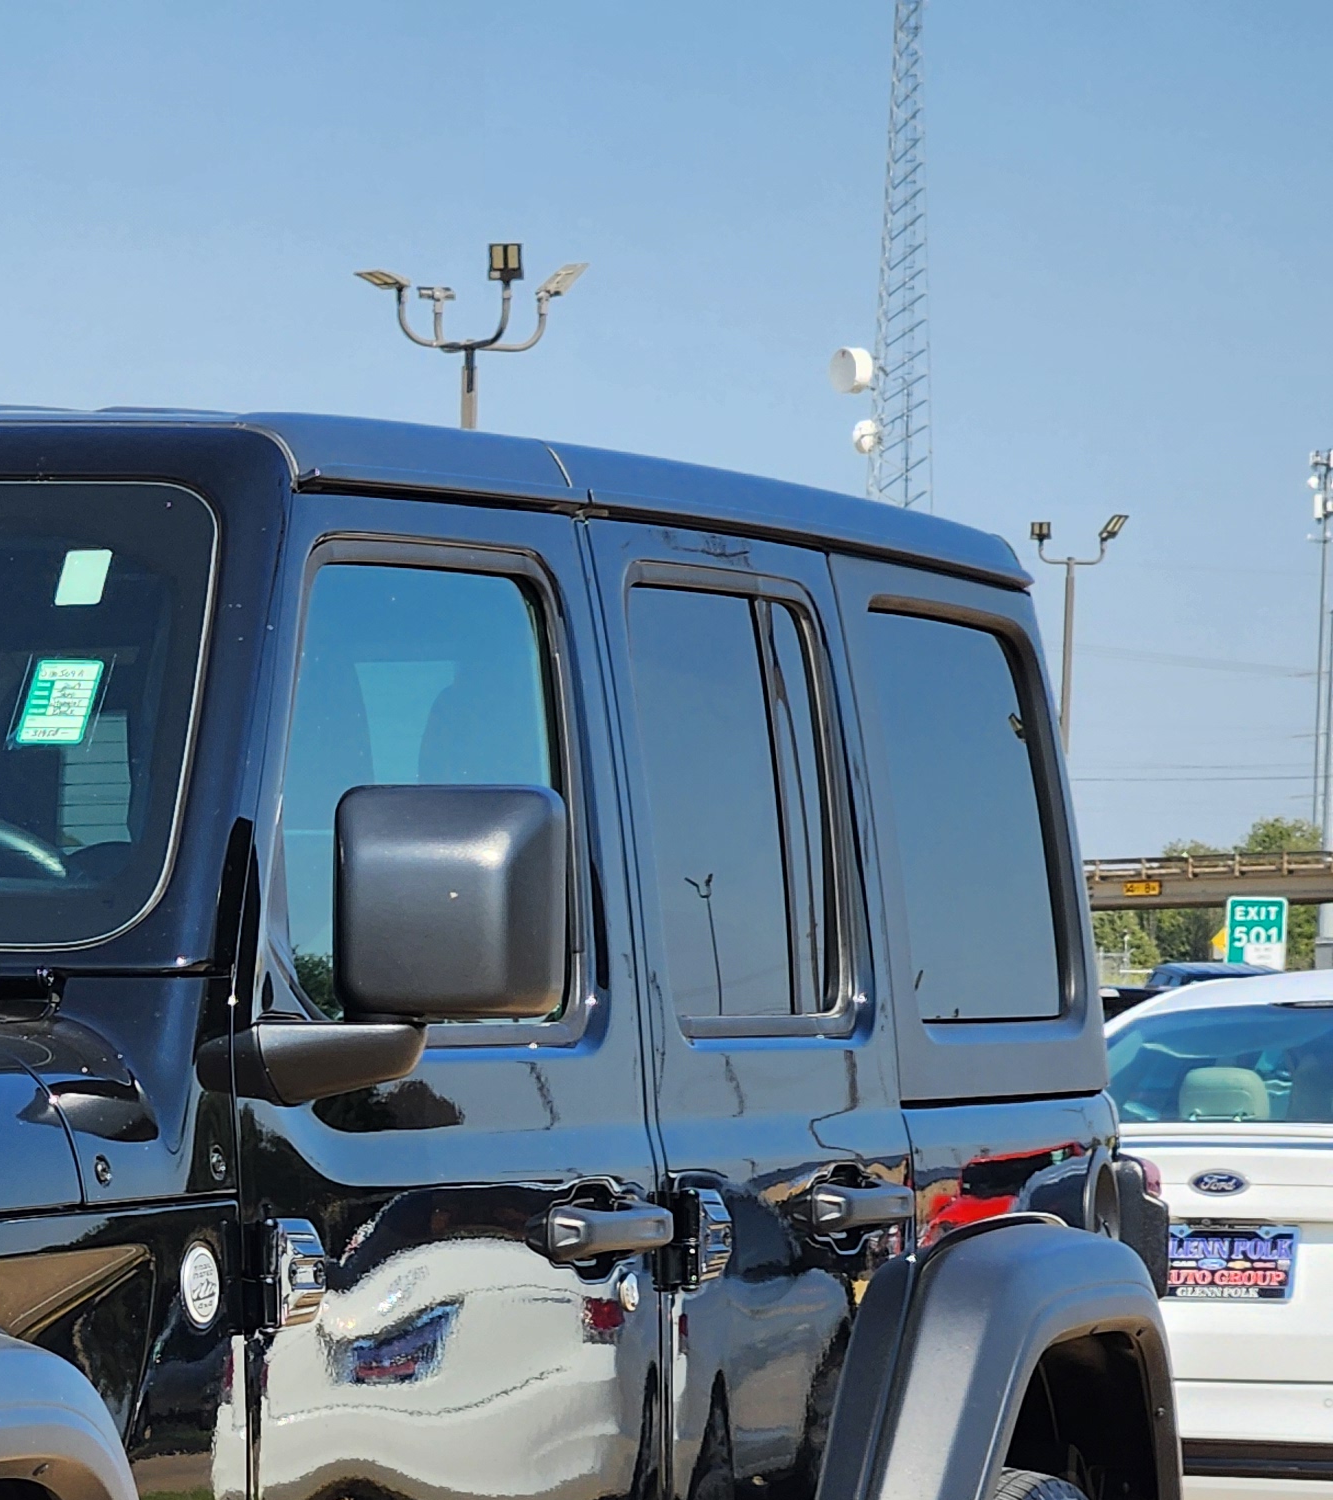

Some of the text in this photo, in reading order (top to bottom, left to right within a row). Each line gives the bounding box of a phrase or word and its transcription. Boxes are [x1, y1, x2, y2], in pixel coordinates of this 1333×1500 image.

[1234, 905, 1279, 921] EXIT
[1233, 926, 1279, 948] 501
[1200, 1174, 1237, 1191] Ford
[1169, 1237, 1293, 1260] LENN POLK
[1214, 1270, 1286, 1286] GROUP
[1176, 1286, 1259, 1298] GLENN POLK
